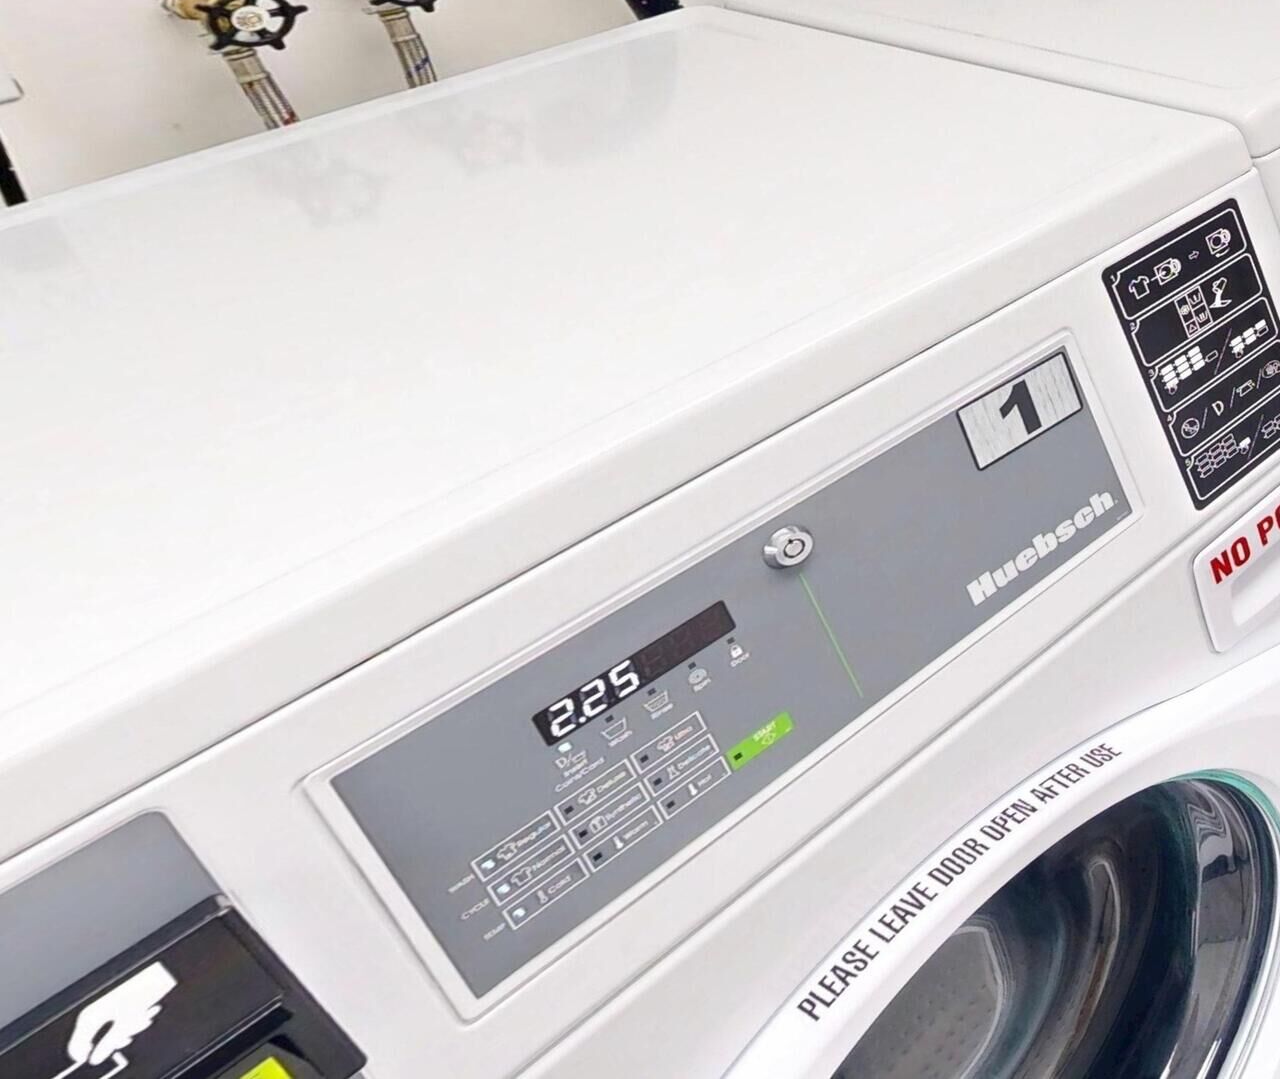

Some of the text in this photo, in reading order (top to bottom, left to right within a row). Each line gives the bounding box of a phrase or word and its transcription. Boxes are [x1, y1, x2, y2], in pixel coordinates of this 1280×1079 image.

[998, 379, 1043, 435] 1
[965, 489, 1115, 607] Huebsch
[1209, 536, 1251, 585] NO
[551, 659, 641, 738] 2.25
[752, 720, 778, 743] START
[460, 845, 566, 920] CYCLE Normal
[547, 875, 572, 895] Cold
[797, 742, 1123, 1022] PLEASE LEAVE DOOR OPEN AFTER USE
